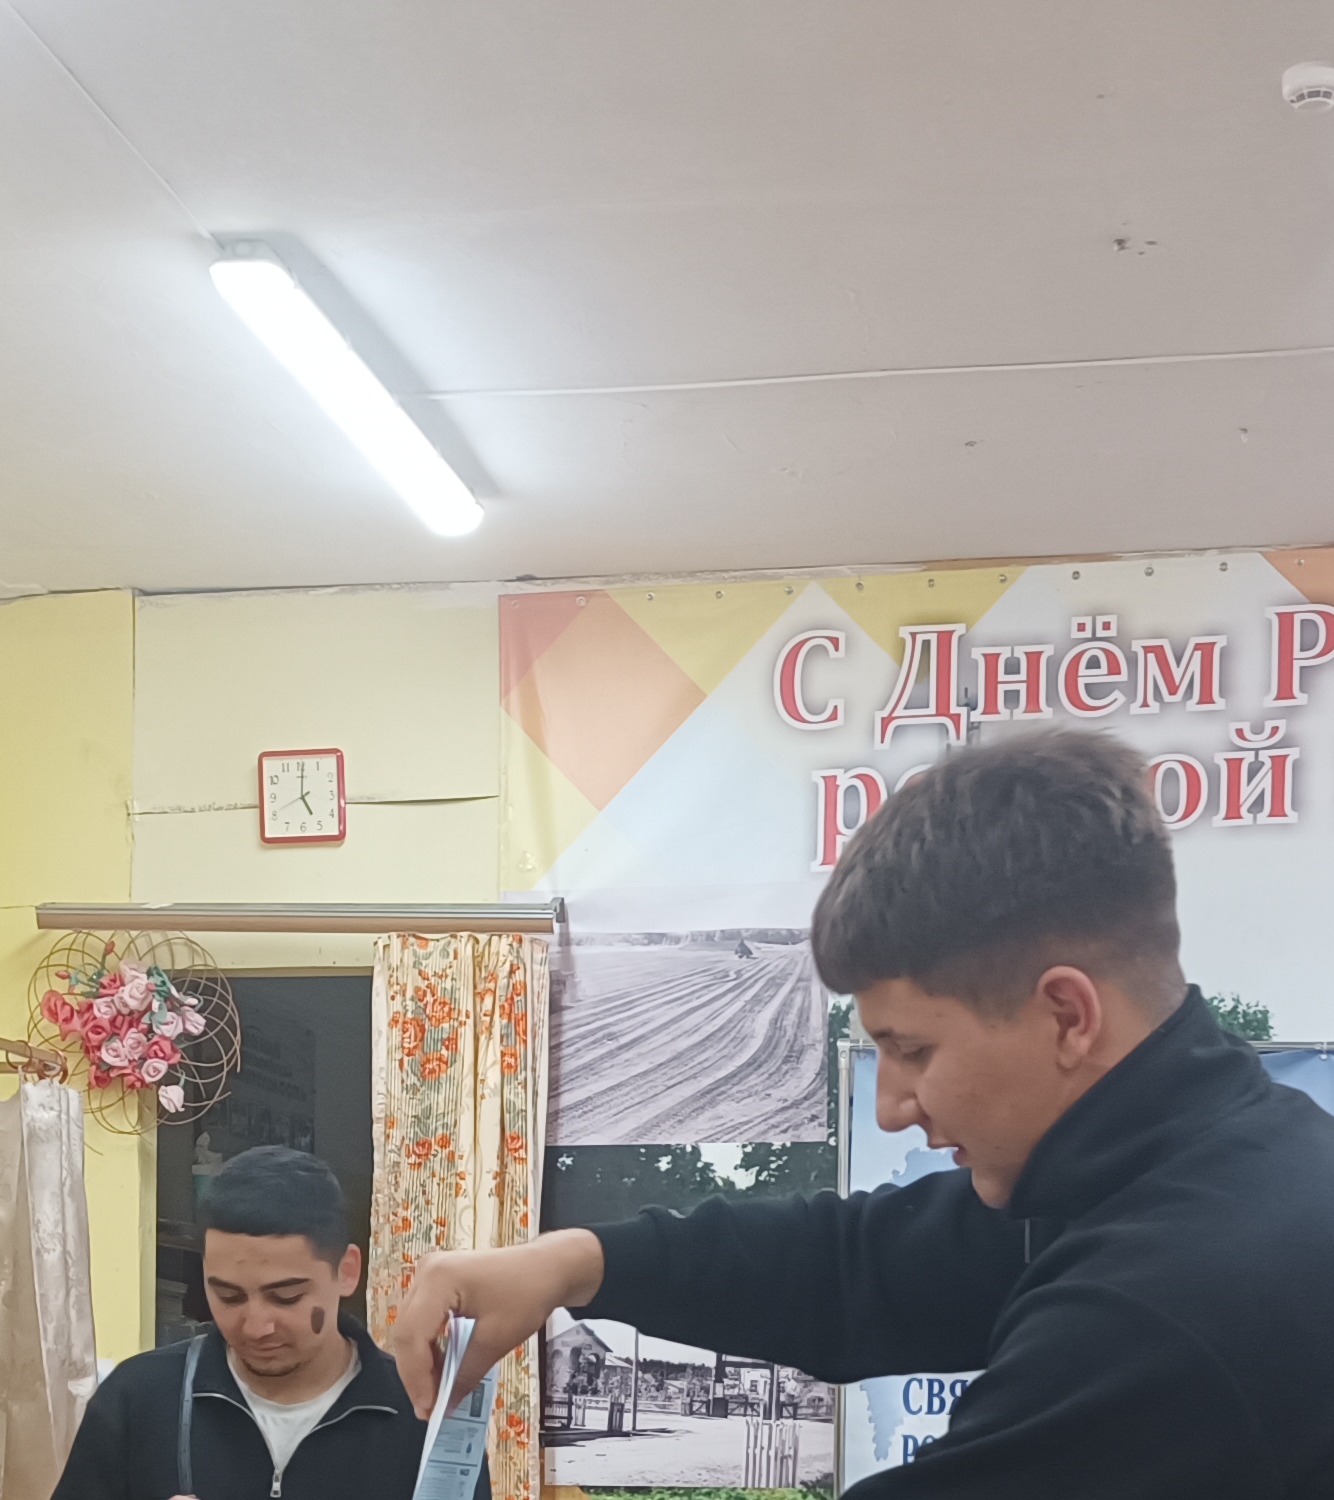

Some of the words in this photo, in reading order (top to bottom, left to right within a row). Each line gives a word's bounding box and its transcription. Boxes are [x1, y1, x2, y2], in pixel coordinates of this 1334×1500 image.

[773, 630, 846, 730] С
[874, 615, 1229, 750] Днём
[811, 720, 1300, 872] рой
[902, 1377, 969, 1416] СВЯ
